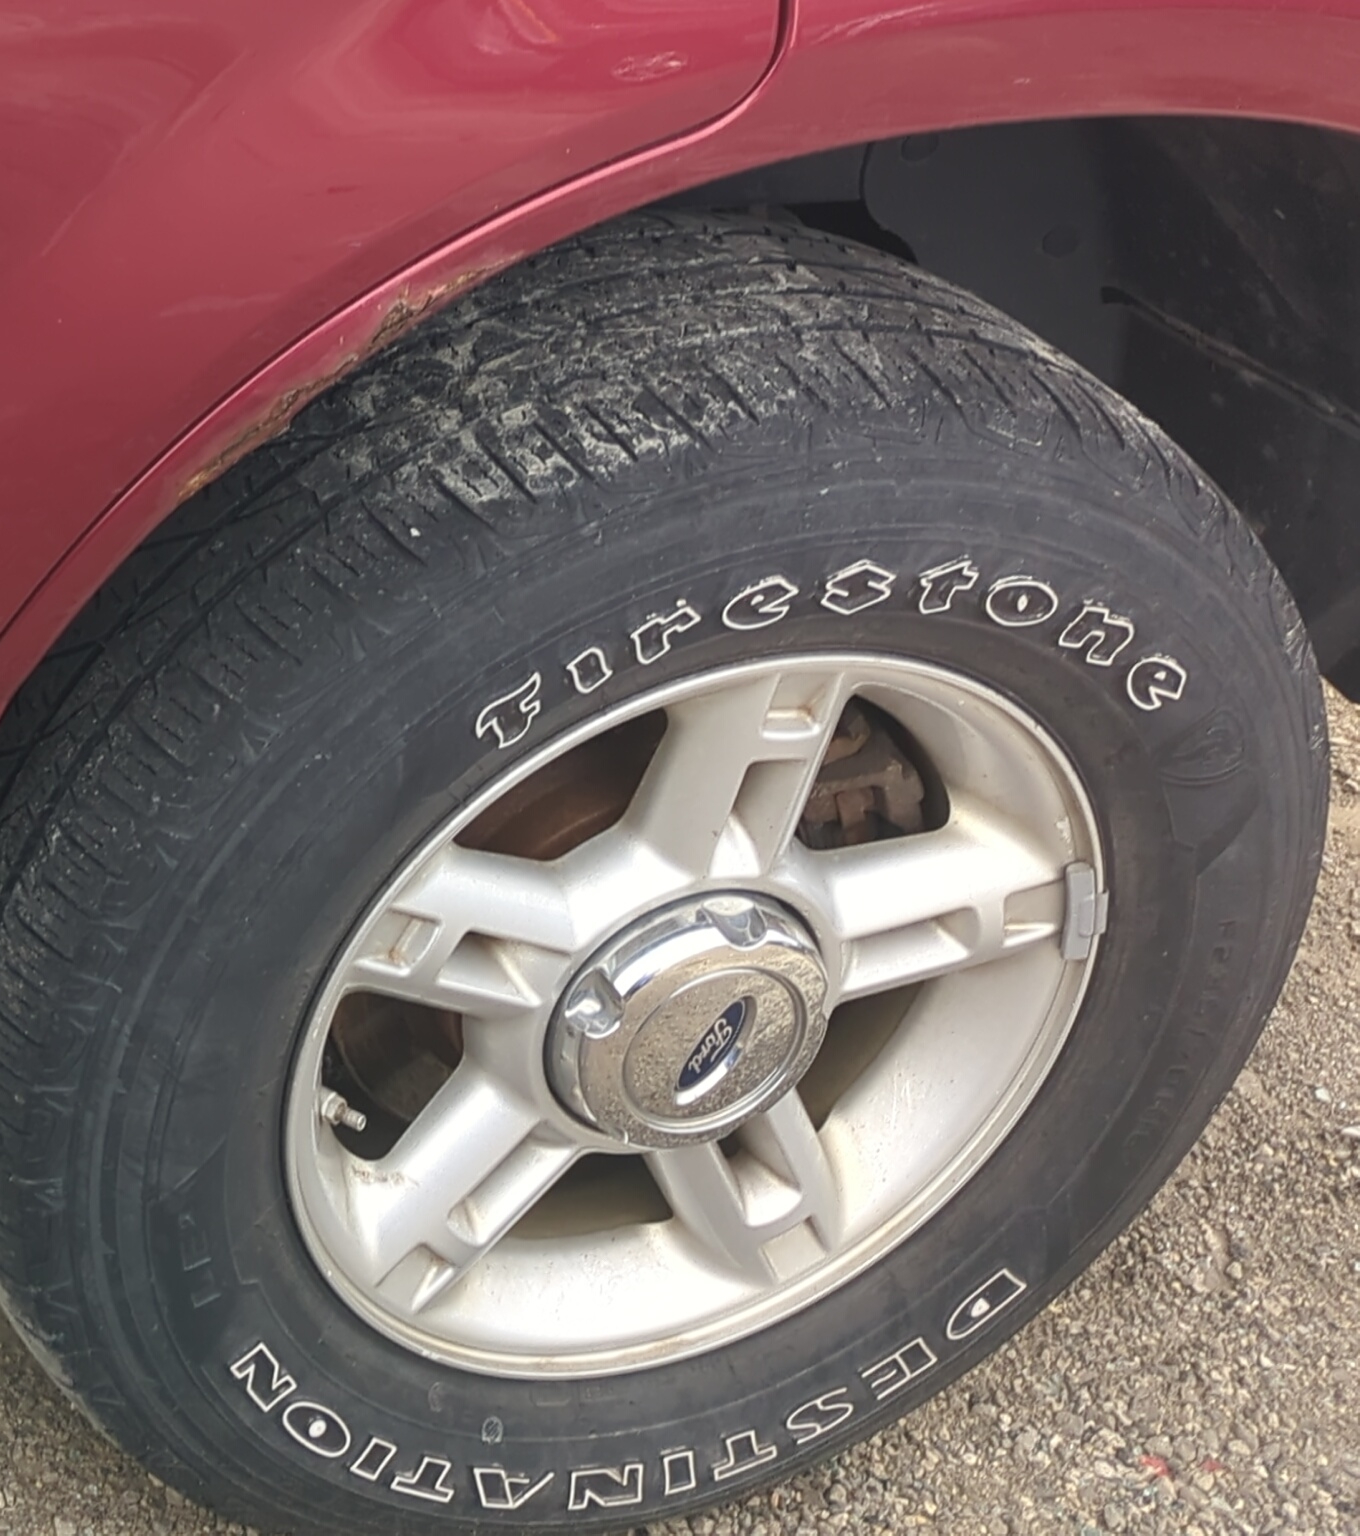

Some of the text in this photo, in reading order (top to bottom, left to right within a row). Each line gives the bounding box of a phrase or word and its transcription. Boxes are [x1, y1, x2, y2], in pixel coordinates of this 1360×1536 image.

[475, 558, 1187, 749] Firestone
[687, 1017, 733, 1075] Ford
[230, 1267, 1027, 1511] DESTINATION
